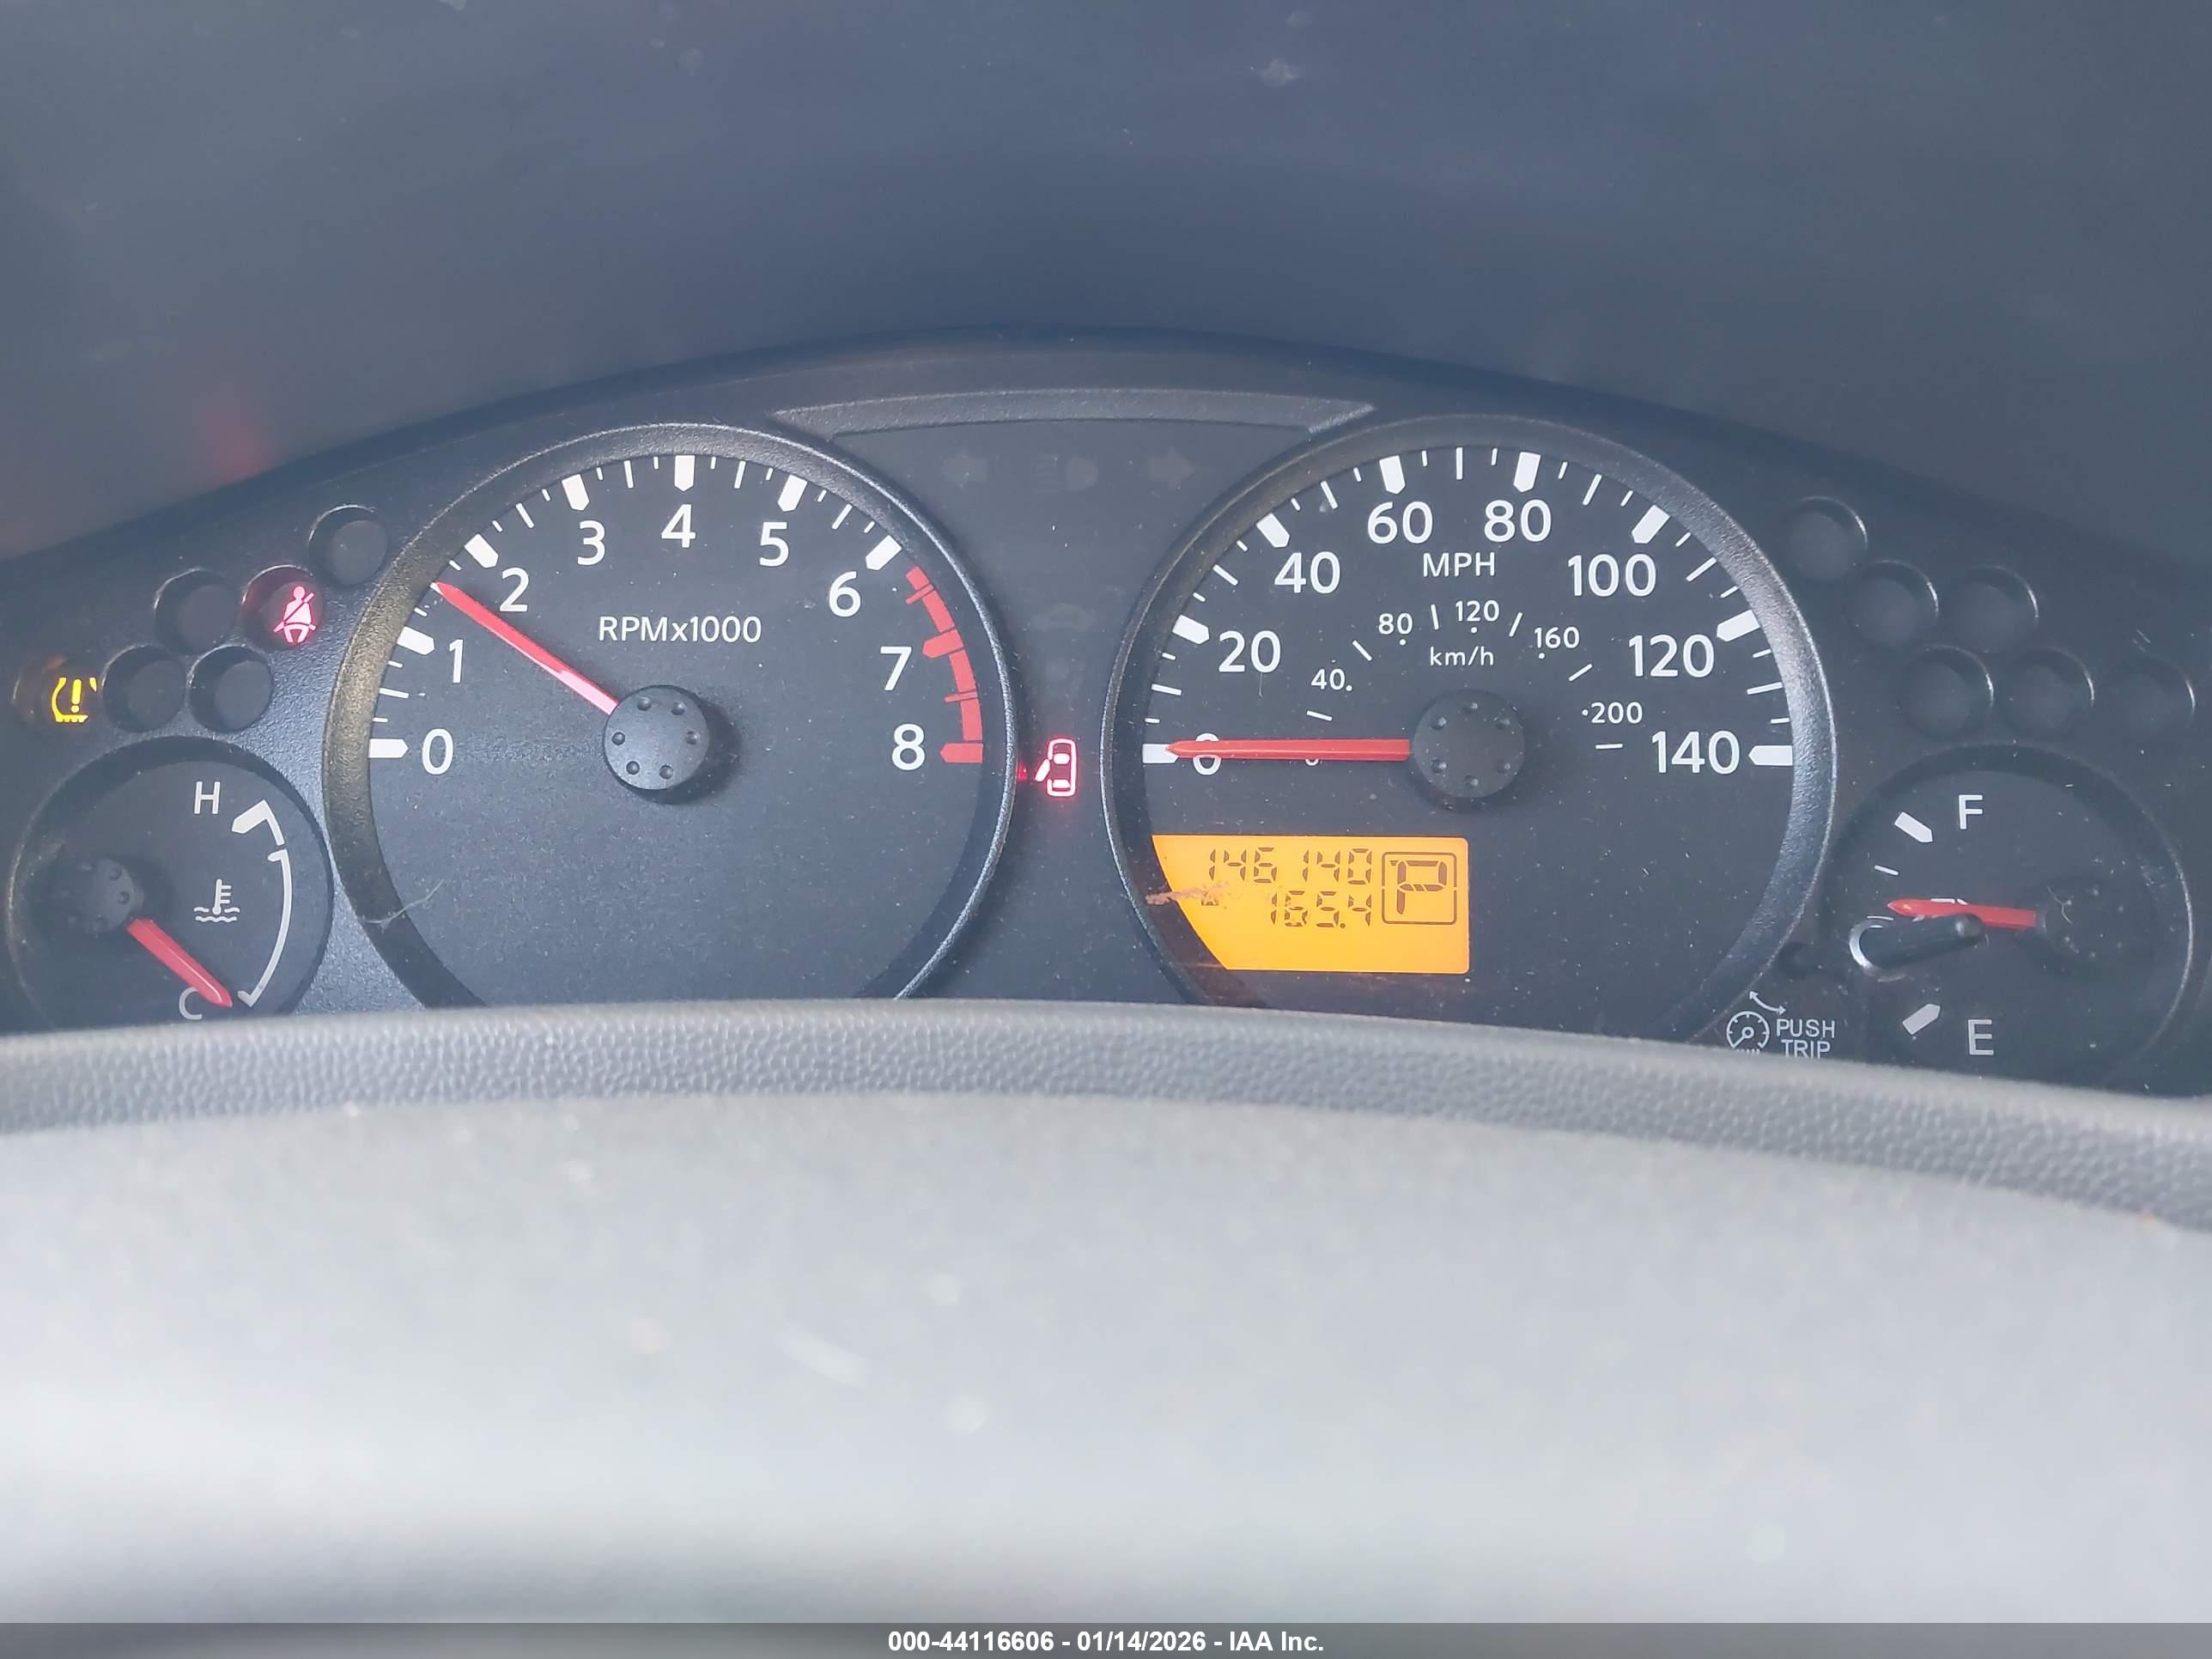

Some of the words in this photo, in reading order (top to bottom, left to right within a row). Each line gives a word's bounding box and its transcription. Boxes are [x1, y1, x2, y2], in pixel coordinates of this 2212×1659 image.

[660, 503, 696, 549] 4
[1367, 501, 1433, 544] 60
[1484, 499, 1552, 543] 80
[577, 520, 605, 566] 3
[759, 521, 789, 567] 5
[1423, 551, 1495, 577] MPH
[499, 567, 529, 612] 2
[829, 571, 861, 617] 6
[1274, 551, 1340, 594] 40
[1568, 553, 1656, 597] 100
[599, 616, 762, 643] RPMx1000
[1378, 612, 1413, 635] 80
[1455, 599, 1500, 622] 120
[1218, 630, 1281, 673] 20
[1430, 646, 1494, 666] km/h
[1534, 626, 1580, 649] 160
[1628, 634, 1715, 678] 120
[448, 639, 464, 684] 1
[880, 646, 912, 691] 7
[1310, 668, 1346, 690] 40
[1591, 702, 1643, 724] 200
[422, 728, 453, 775] 0
[891, 723, 926, 771] 8
[1192, 732, 1222, 776] 0
[1651, 730, 1740, 775] 140
[194, 781, 221, 815] H
[1958, 794, 1983, 830] F
[1389, 859, 1449, 916] P
[1270, 890, 1372, 929] 165.4
[178, 985, 204, 1021] C
[1776, 1018, 1835, 1039] PUSH
[1779, 1038, 1832, 1060] TRIP
[1967, 1018, 1994, 1055] E
